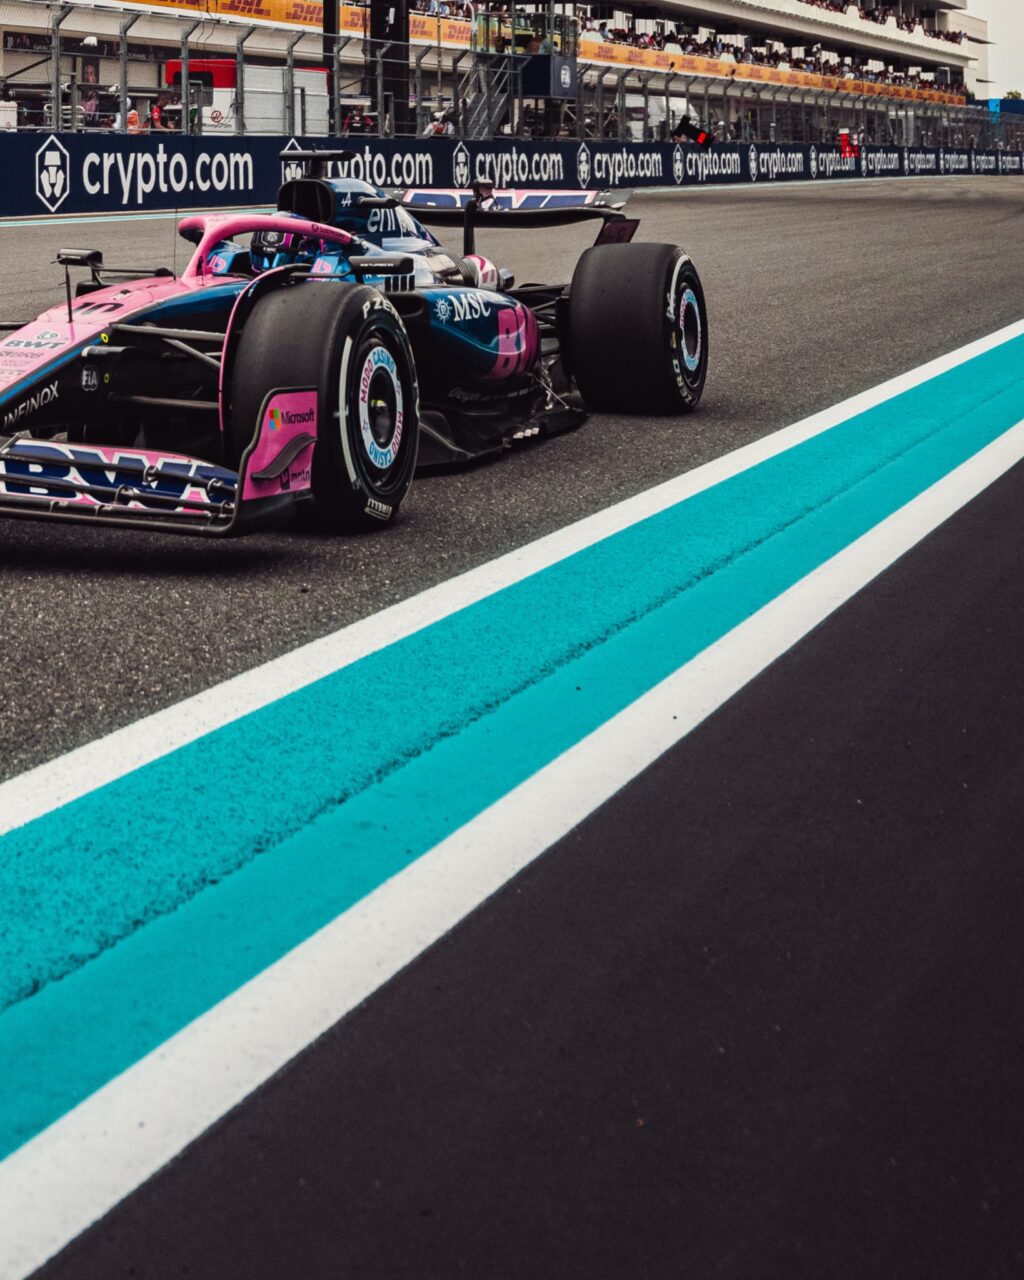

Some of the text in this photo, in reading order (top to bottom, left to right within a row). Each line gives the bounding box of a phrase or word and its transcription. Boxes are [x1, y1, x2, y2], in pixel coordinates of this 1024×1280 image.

[82, 143, 254, 206] crypto.com
[476, 147, 563, 188] crypto.com
[594, 148, 663, 184] crypto.com
[686, 148, 741, 181] crypto.com
[759, 148, 804, 178] crypto.com
[868, 149, 899, 174] crypto.com
[367, 205, 396, 232] eni
[449, 292, 492, 322] MSC
[4, 339, 66, 349] BWT
[372, 348, 395, 375] CASINO
[360, 358, 374, 404] MODO
[3, 380, 59, 430] INFINOX
[280, 409, 316, 426] Microsoft
